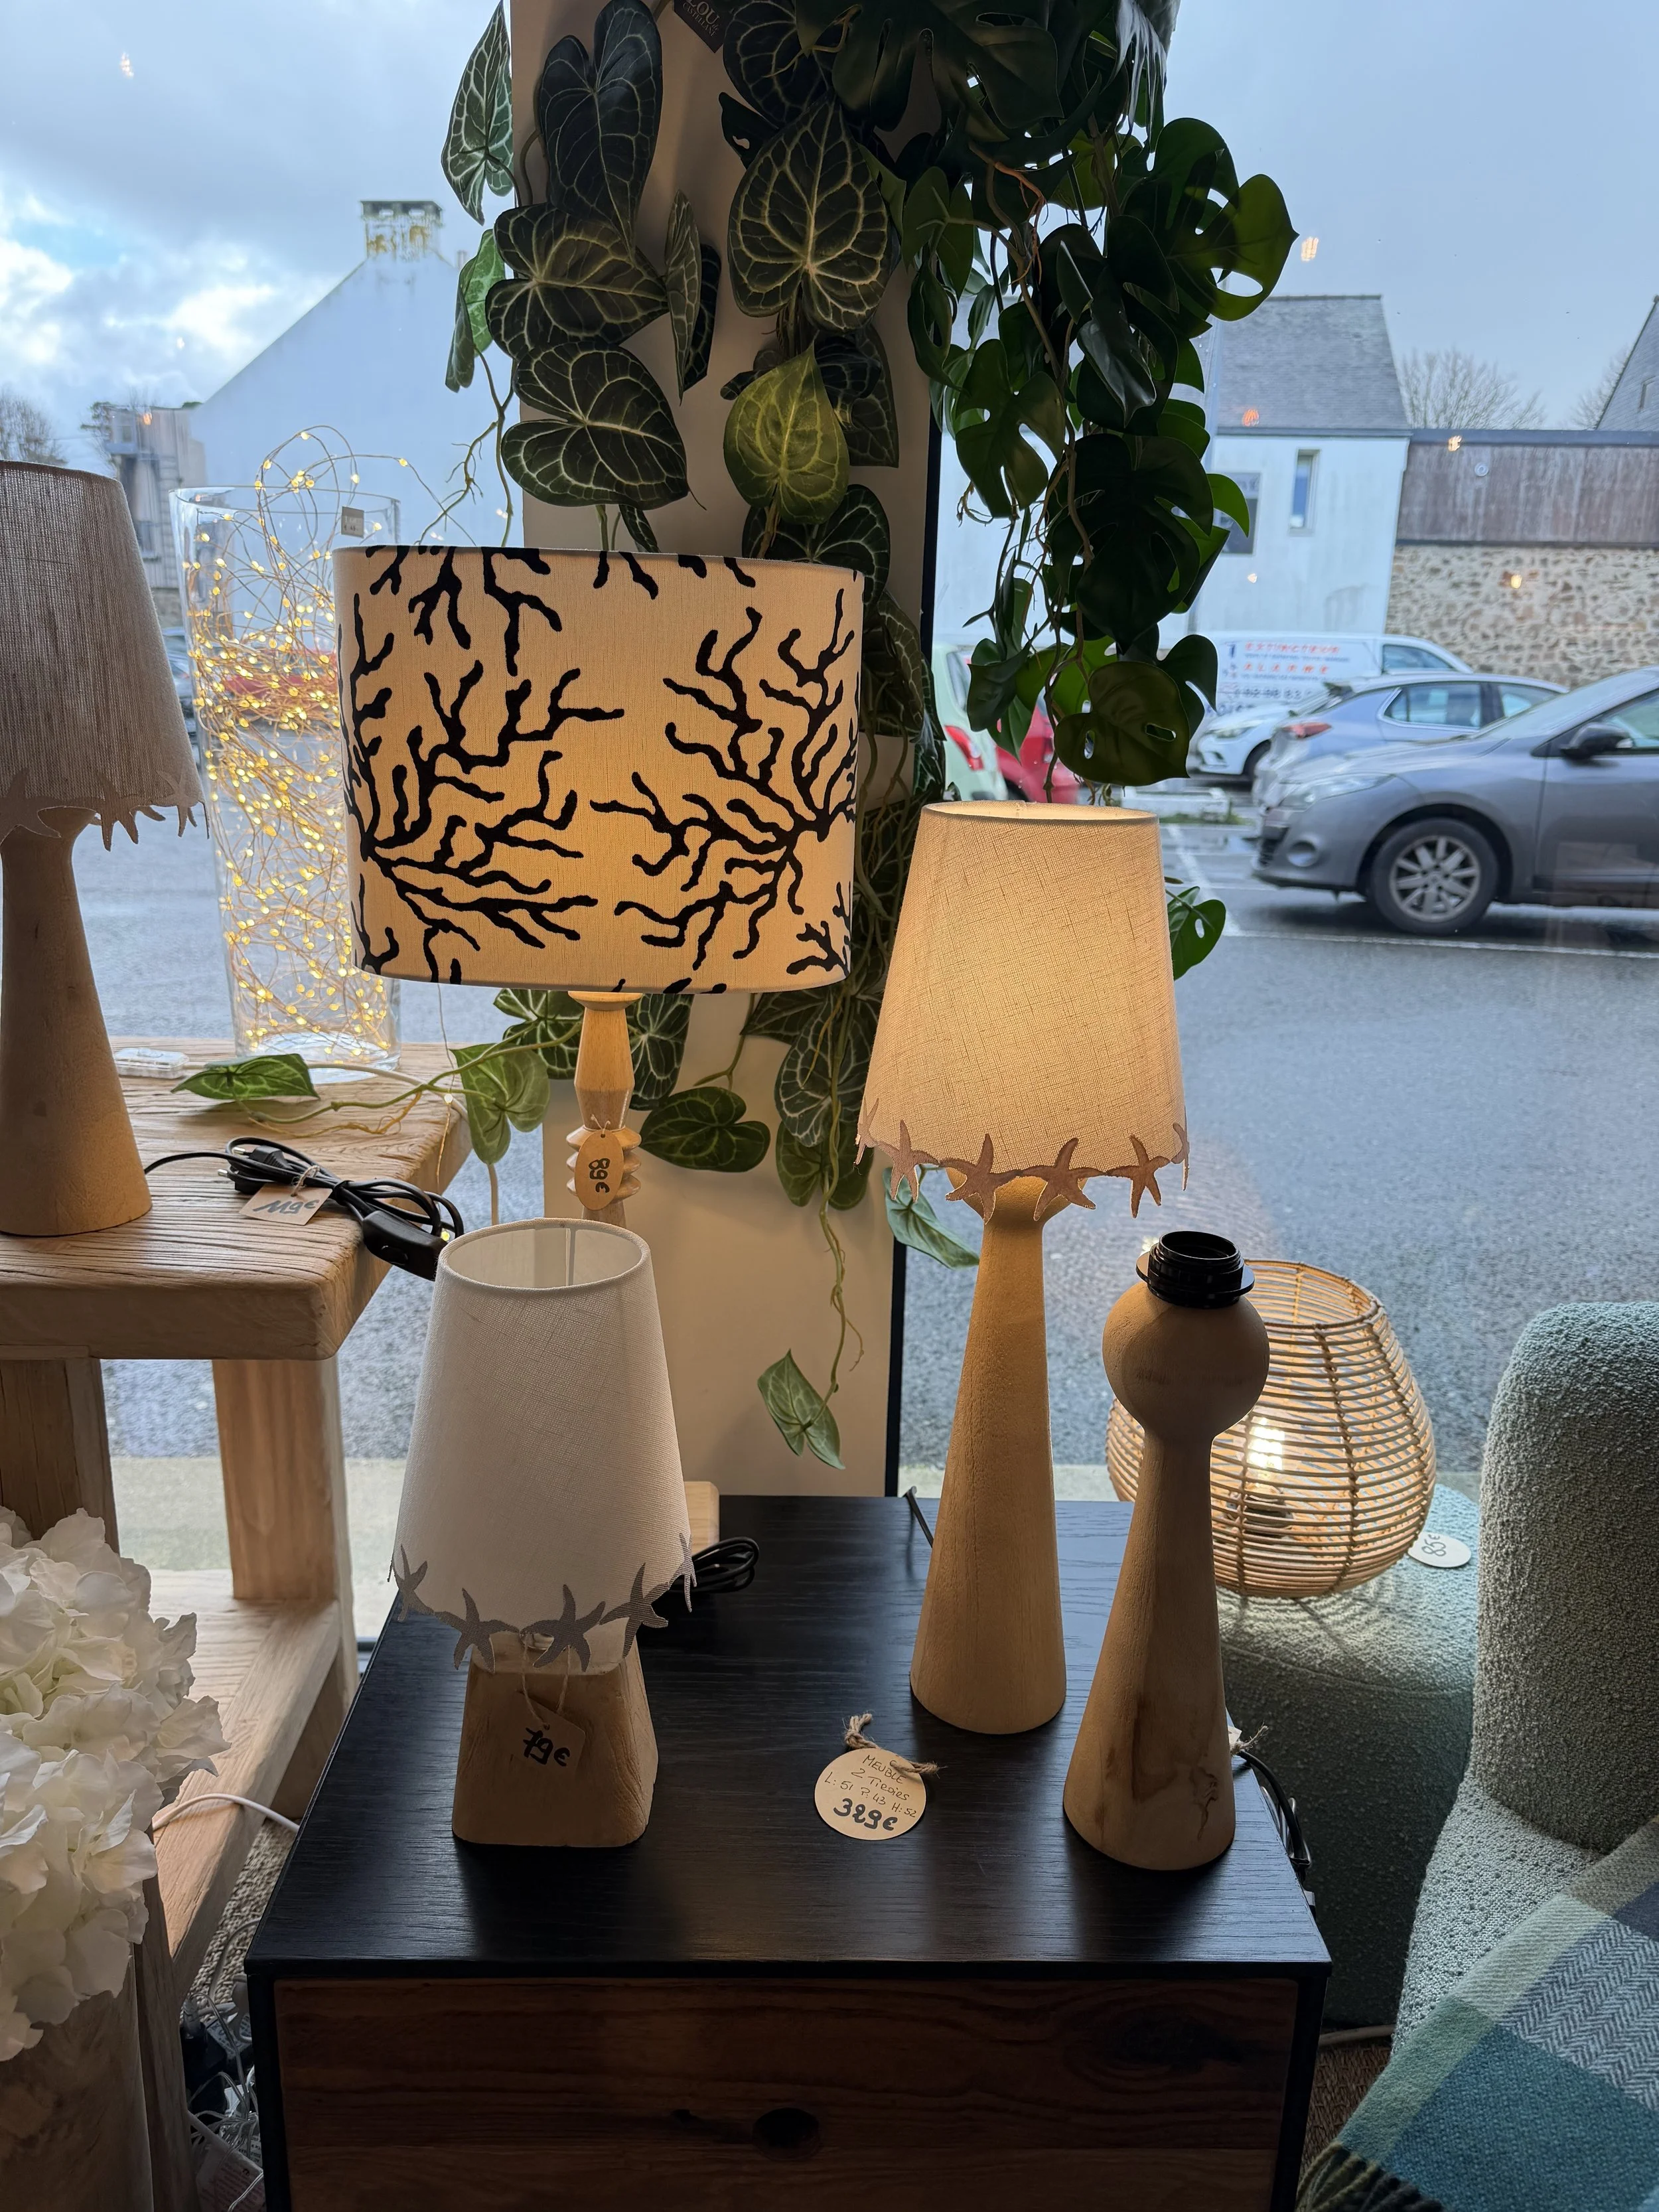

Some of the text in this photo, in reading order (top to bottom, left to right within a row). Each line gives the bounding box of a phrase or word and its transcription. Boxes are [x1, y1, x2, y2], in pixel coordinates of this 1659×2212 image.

[588, 1157, 611, 1194] 89€
[522, 1727, 571, 1767] 79€
[851, 1768, 866, 1779] 2
[862, 1754, 907, 1785] MEUBLE
[824, 1771, 917, 1818] L: 51 P: 43 H: 52
[833, 1797, 899, 1832] 329€
